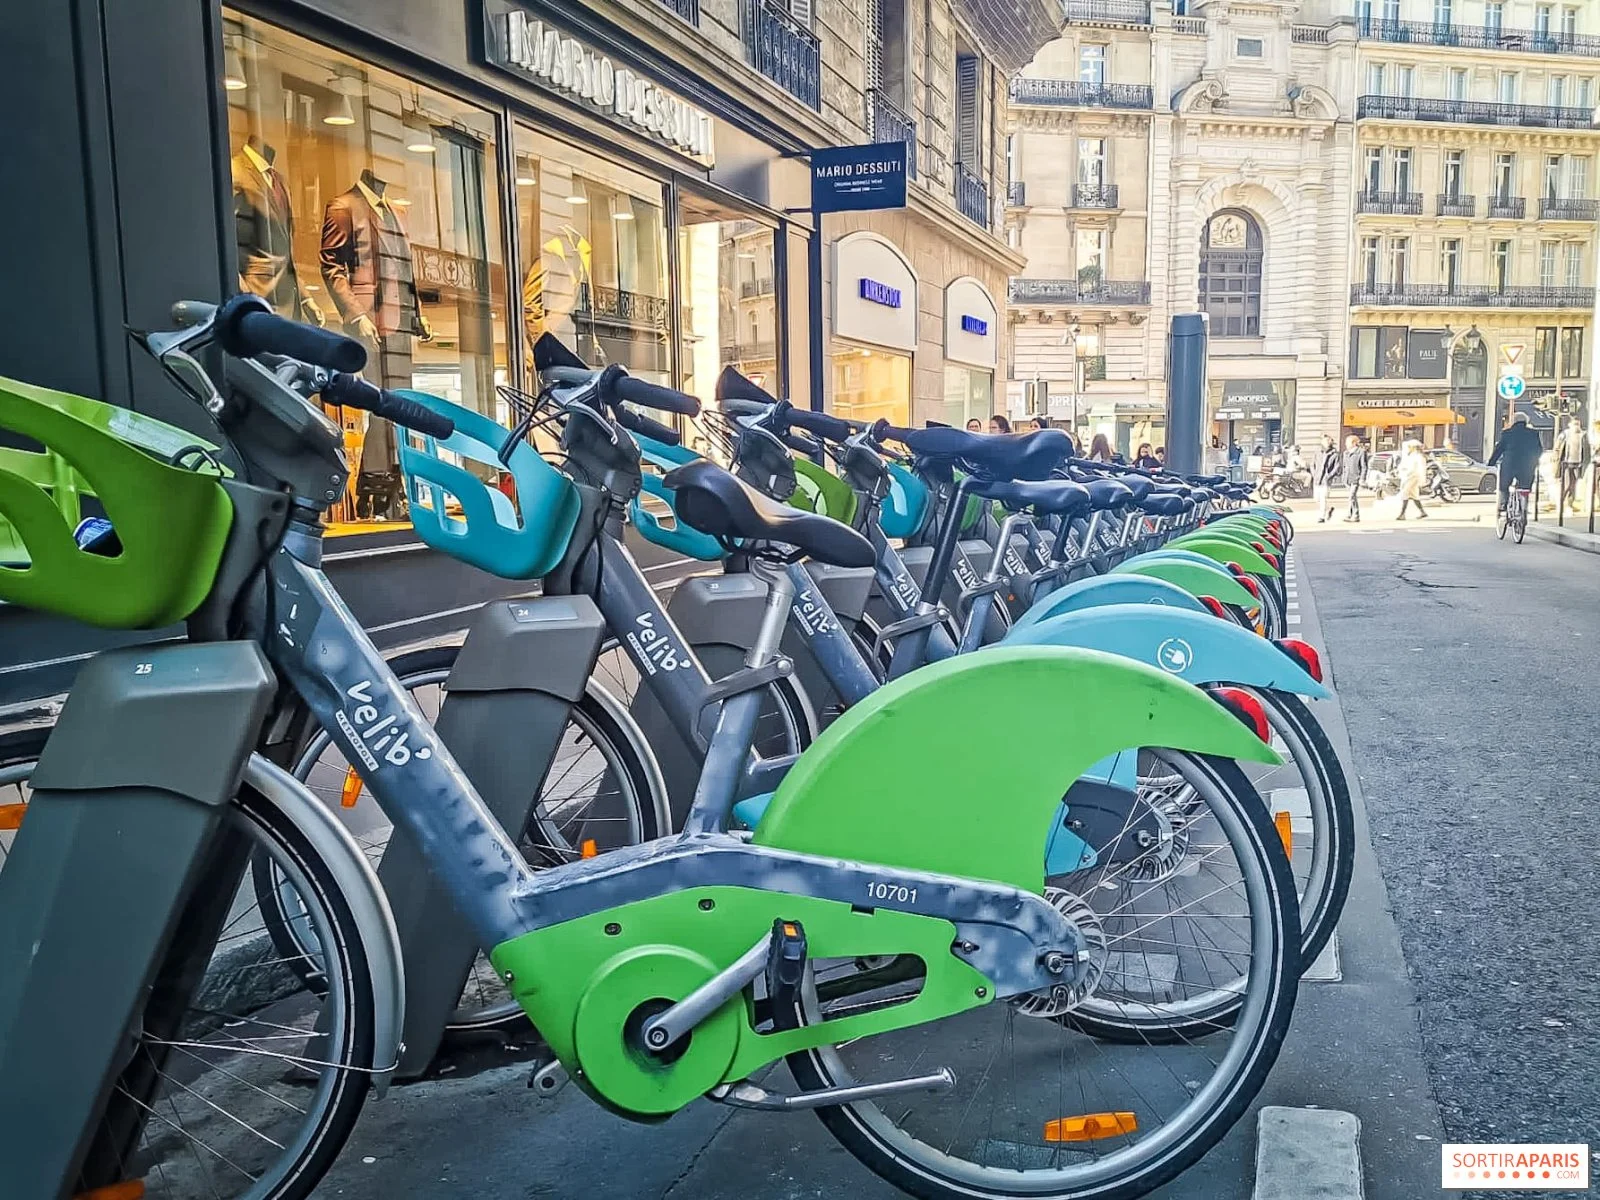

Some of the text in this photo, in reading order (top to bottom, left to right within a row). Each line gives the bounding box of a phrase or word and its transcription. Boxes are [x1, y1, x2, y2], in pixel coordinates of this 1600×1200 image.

[509, 11, 615, 106] MARIO
[816, 161, 901, 178] MARIO DESSUTI
[1227, 395, 1269, 403] MONOPRIX
[1399, 398, 1437, 407] FRANCE
[135, 663, 153, 675] 25
[336, 710, 378, 771] METROPOLE
[867, 882, 917, 904] 10701
